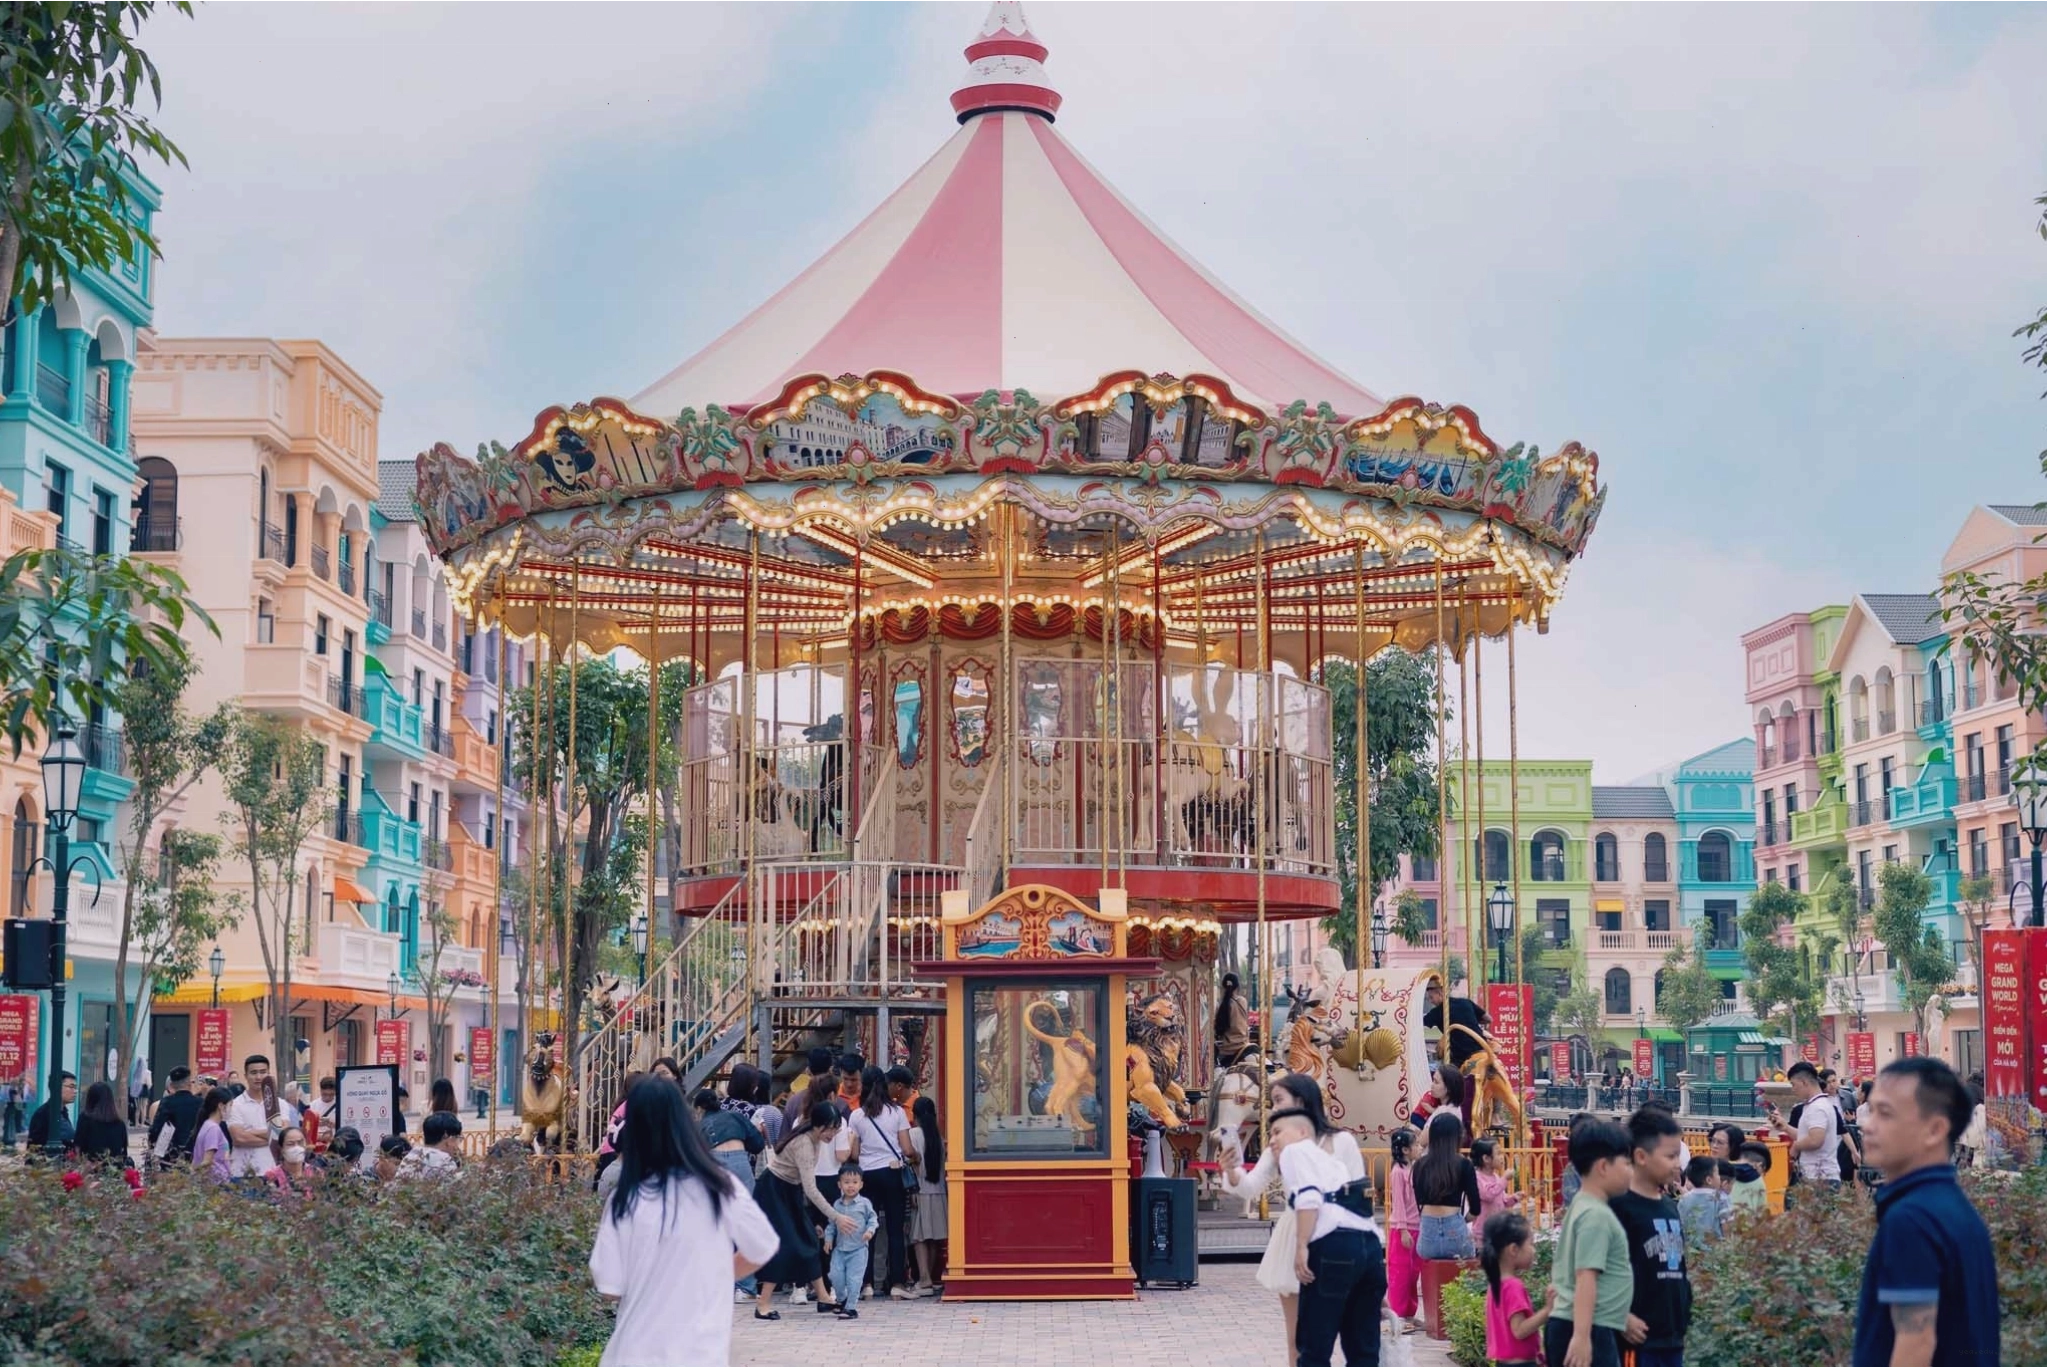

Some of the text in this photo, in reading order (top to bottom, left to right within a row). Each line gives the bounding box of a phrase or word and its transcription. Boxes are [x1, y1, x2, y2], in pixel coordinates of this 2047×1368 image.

[1994, 962, 2014, 974] MEGA
[1991, 977, 2018, 988] GRAND
[1991, 989, 2018, 1001] WORLD
[1494, 1022, 1527, 1034] LỄ HI
[1498, 1045, 1519, 1055] NHẤ
[1997, 1038, 2014, 1055] MỚI
